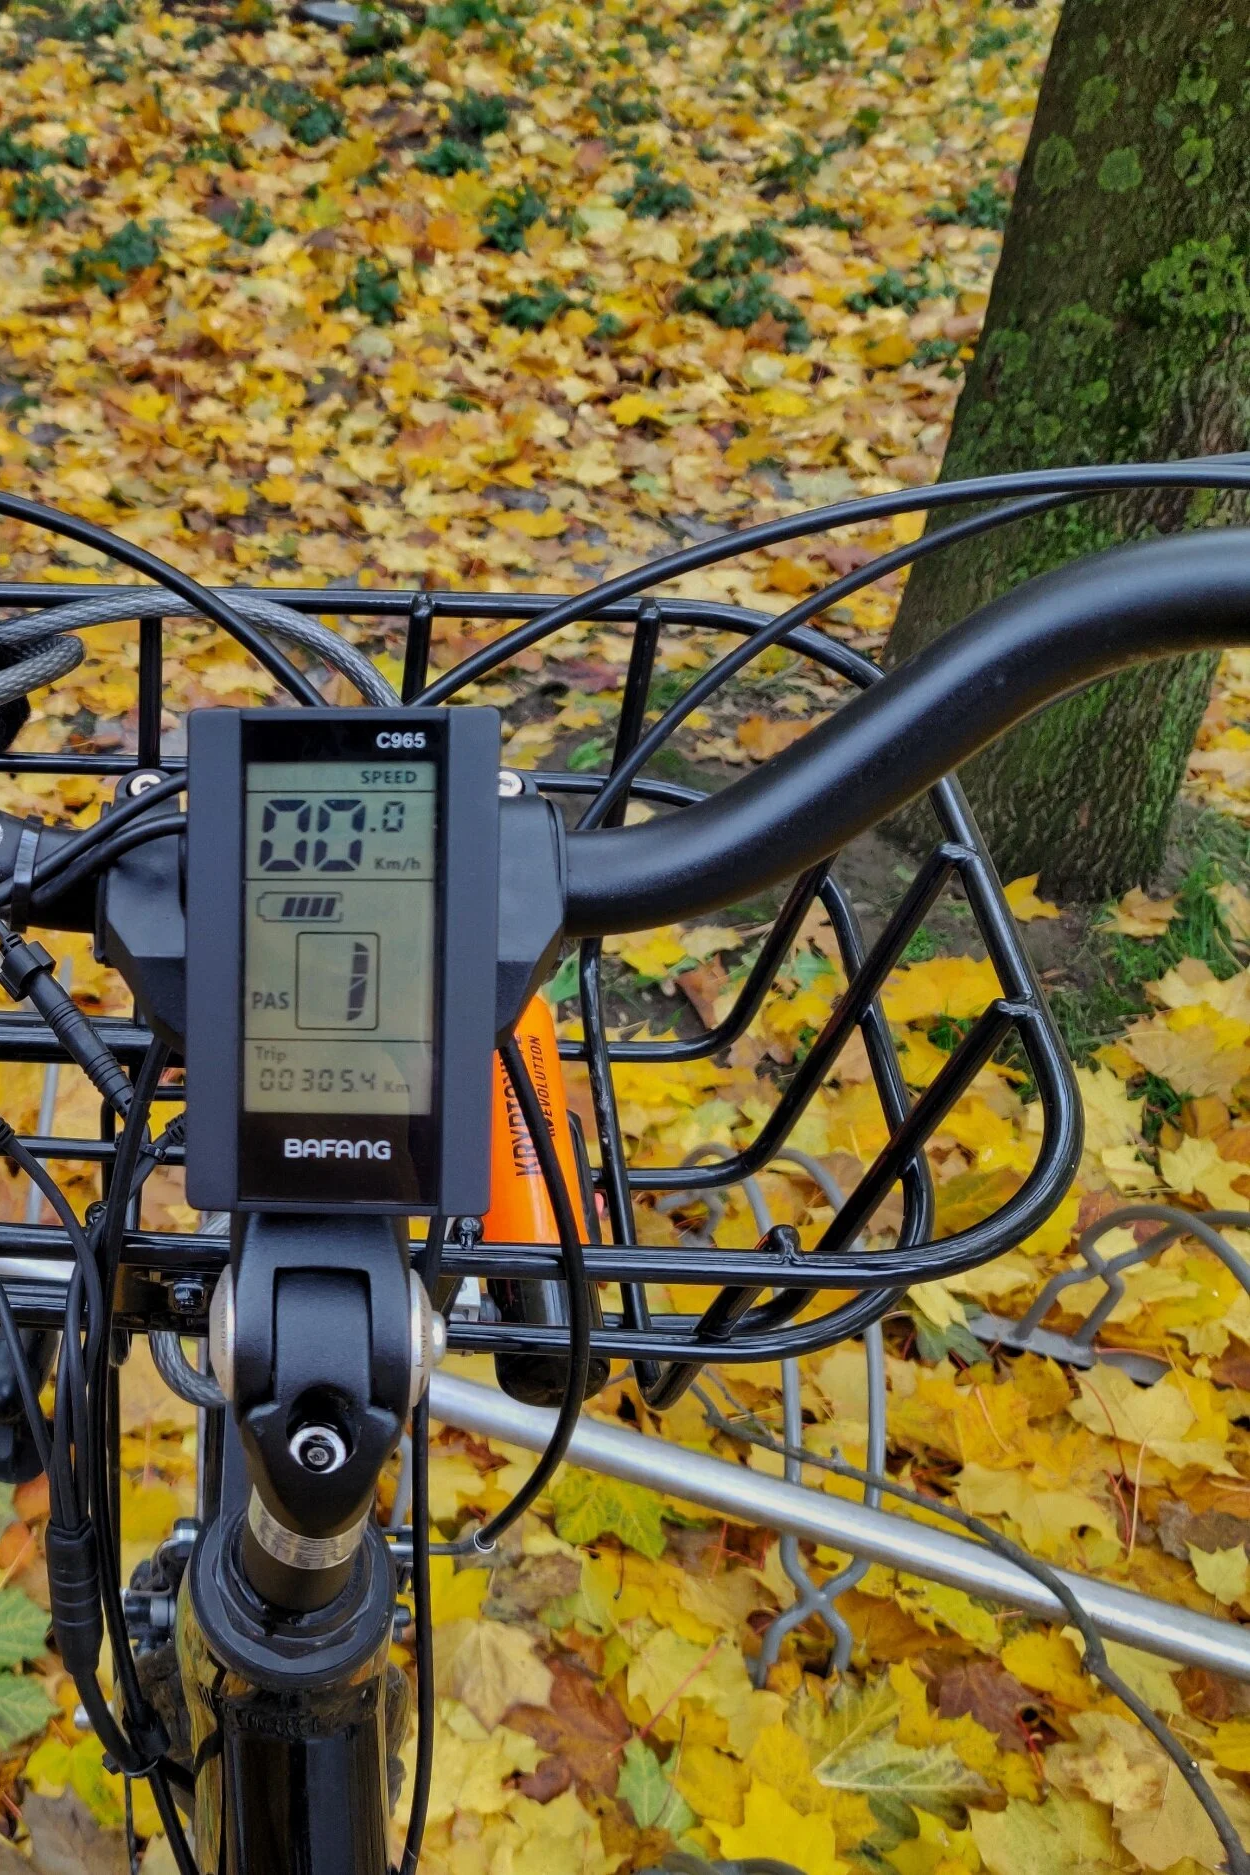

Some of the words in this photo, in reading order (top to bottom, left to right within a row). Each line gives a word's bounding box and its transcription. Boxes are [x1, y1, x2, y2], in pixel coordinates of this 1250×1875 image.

[376, 731, 427, 749] C965
[360, 770, 418, 784] SPEED
[374, 857, 421, 871] Km/h
[346, 942, 369, 1022] 1
[252, 991, 290, 1010] PAS
[254, 1046, 287, 1064] Trip
[383, 1080, 411, 1093] Km
[284, 1138, 391, 1160] BAFANG
